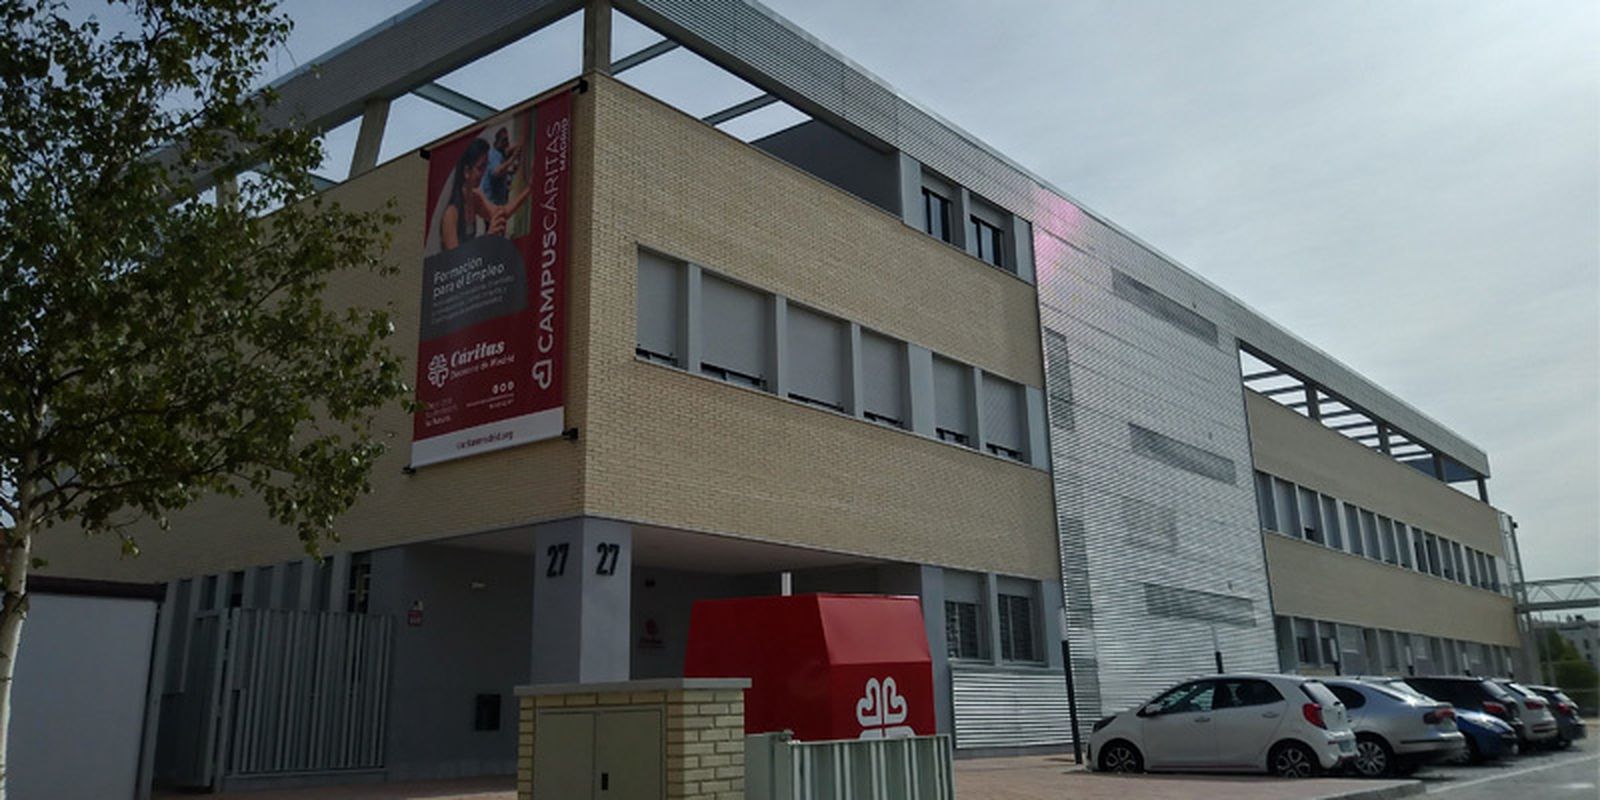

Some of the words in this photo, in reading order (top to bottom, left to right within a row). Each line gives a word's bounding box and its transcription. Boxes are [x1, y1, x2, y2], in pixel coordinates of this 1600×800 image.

[560, 117, 569, 171] MADRID
[433, 257, 483, 285] Formación
[433, 282, 455, 301] para
[456, 275, 465, 289] el
[466, 263, 505, 285] Empleo
[450, 341, 505, 368] Cáritas
[546, 543, 570, 578] 27
[596, 542, 620, 576] 27
